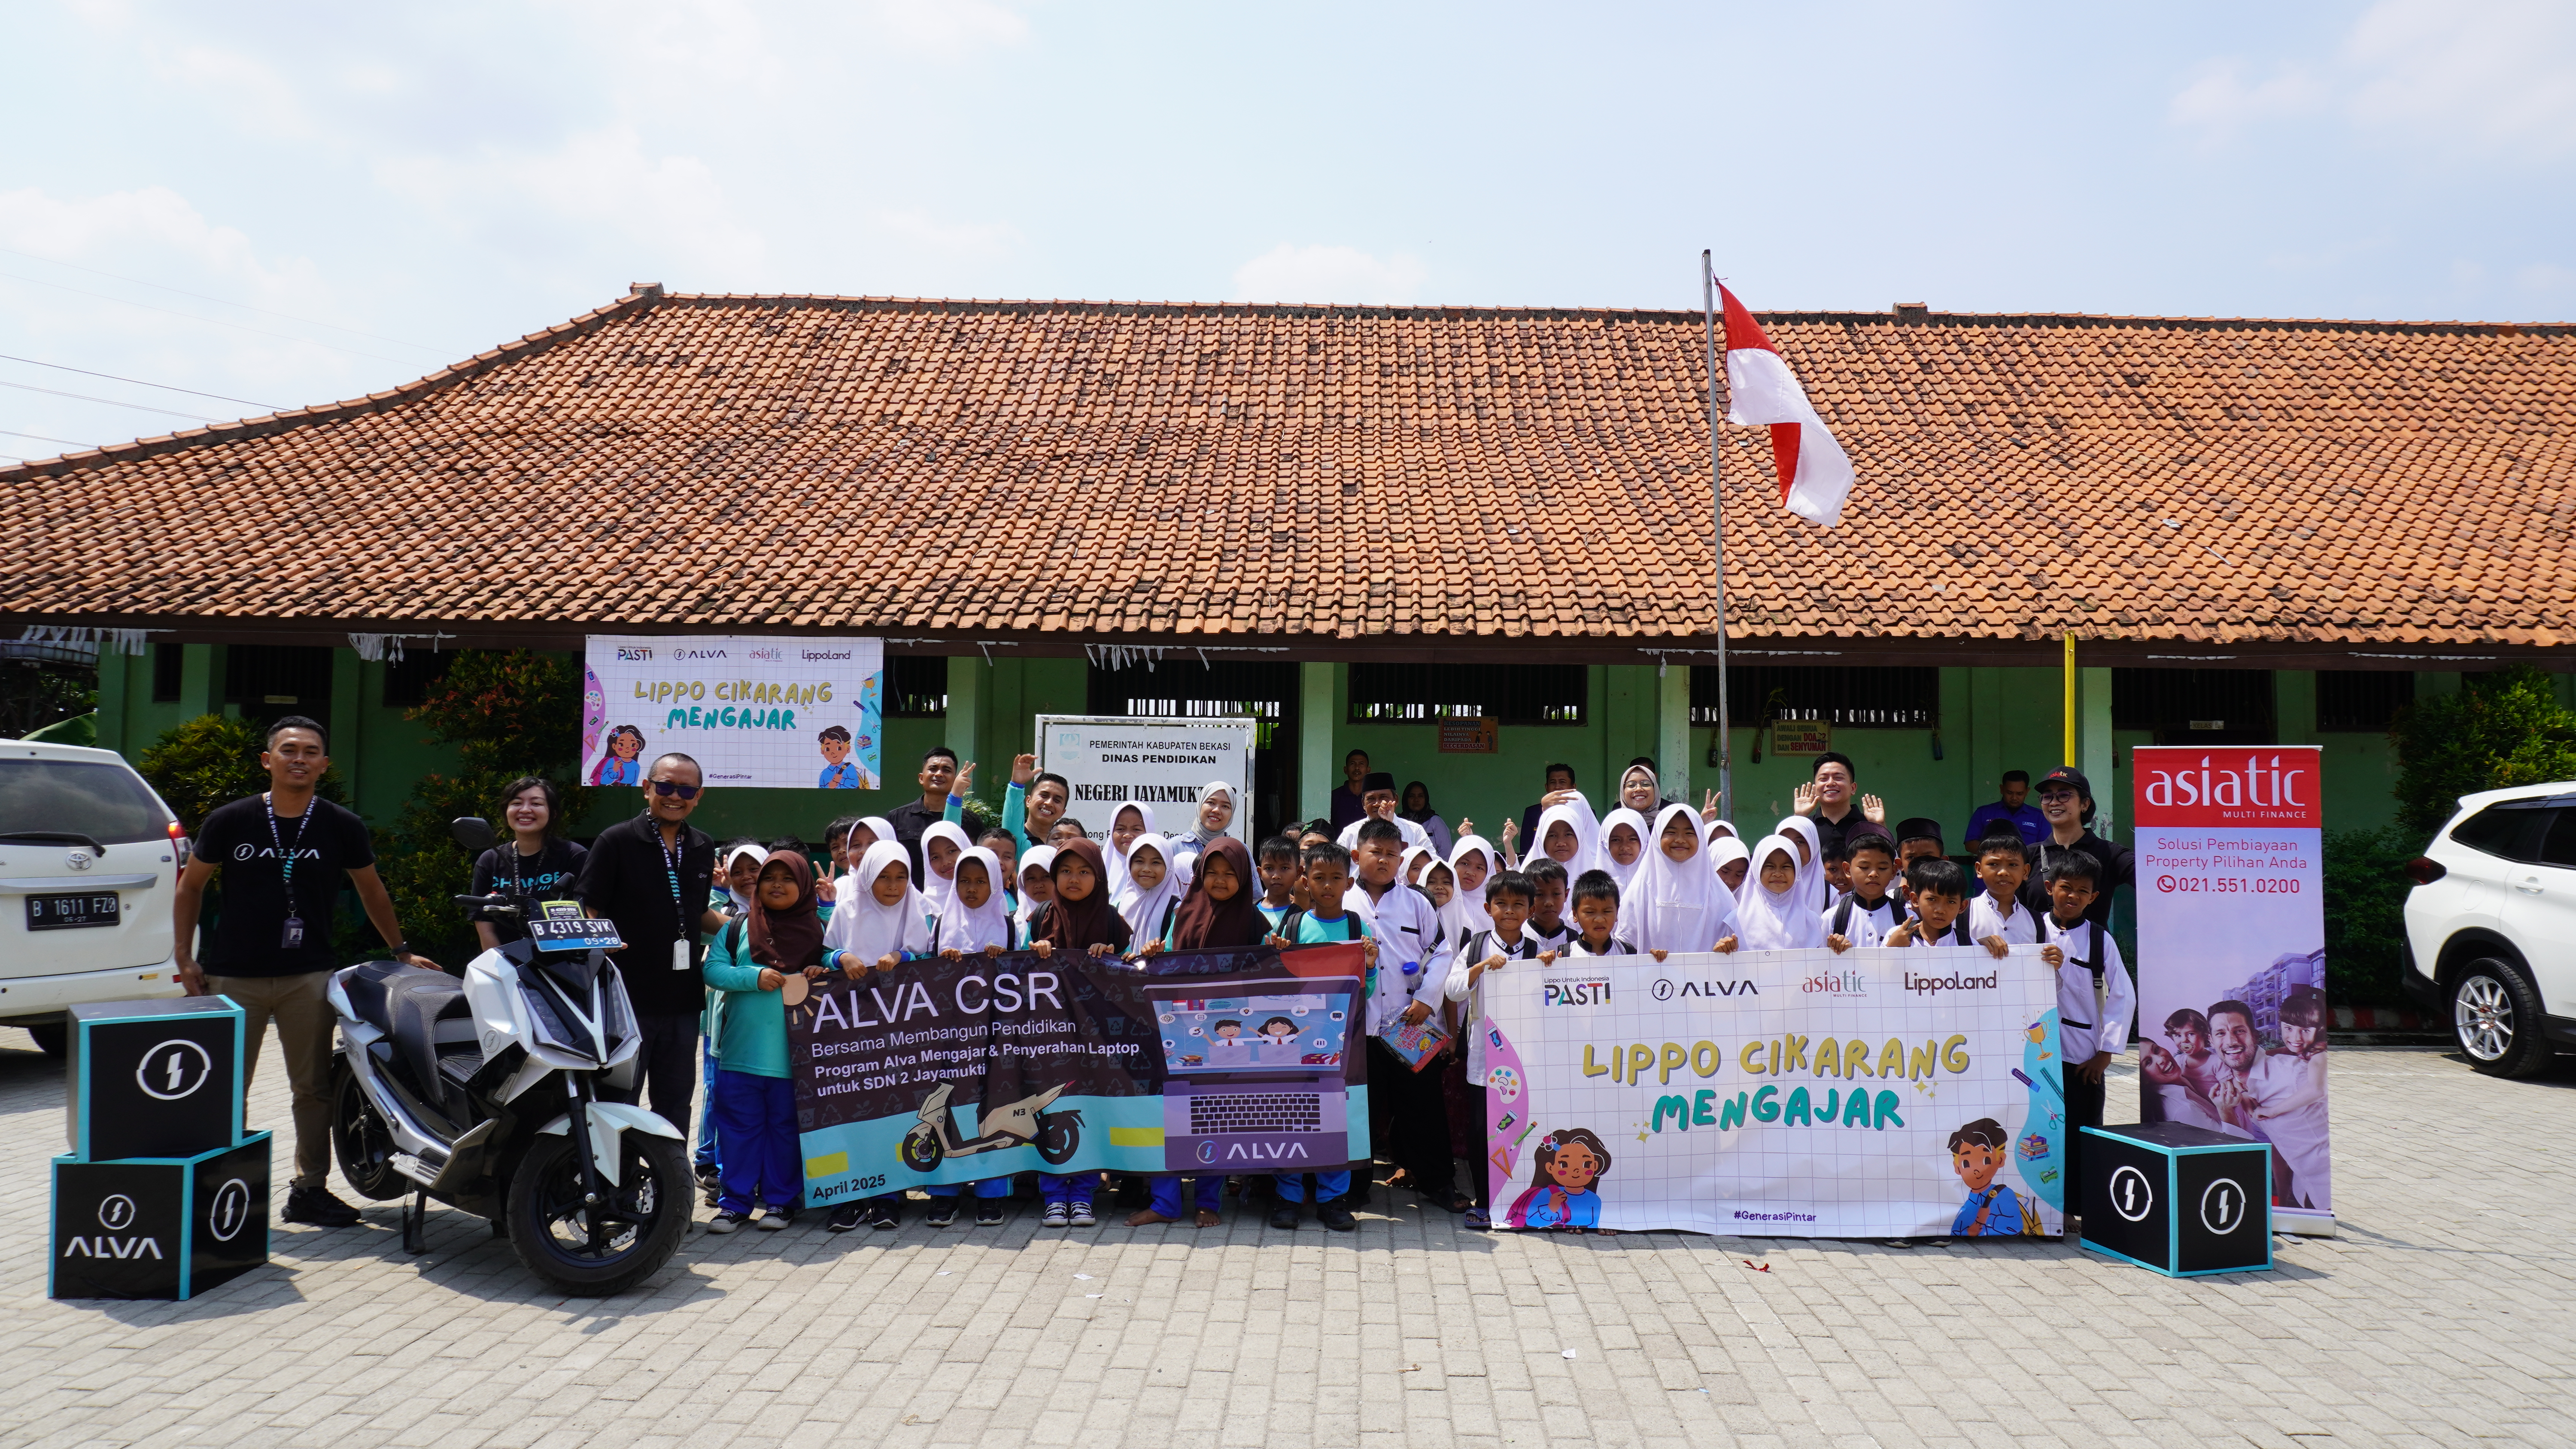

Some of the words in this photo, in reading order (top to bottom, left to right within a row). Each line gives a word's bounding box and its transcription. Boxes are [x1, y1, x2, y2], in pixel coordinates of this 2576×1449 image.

[688, 650, 727, 658] ALVA
[749, 648, 783, 660] asiatic
[802, 649, 851, 662] LippoLand
[635, 680, 705, 704] LIPPO
[715, 679, 832, 705] CIKARANG
[667, 706, 796, 731] MENGAJAR
[1090, 740, 1143, 749] PEMERINTAH
[1146, 741, 1197, 750] KABUPATEN
[1200, 743, 1230, 751] BEKASI
[1804, 733, 1817, 741] DOA
[1790, 742, 1825, 751] SENYUMAN
[1102, 754, 1138, 763] DINAS
[1142, 755, 1216, 764] PENDIDIKAN
[2145, 755, 2306, 806] asiatic
[1075, 784, 1128, 801] NEGERI
[305, 795, 317, 815] HANGE
[301, 817, 309, 829] THE
[657, 836, 666, 847] THE
[2158, 838, 2202, 850] Solusi
[2208, 838, 2298, 853] Pembiayaan
[2147, 855, 2208, 870] Property
[2214, 856, 2264, 868] Pilihan
[2269, 857, 2307, 868] Anda
[2179, 878, 2300, 893] 021.551.0200
[33, 900, 42, 917] B
[55, 898, 84, 915] 1611
[533, 924, 544, 936] B
[550, 921, 583, 934] 4319
[586, 921, 612, 933] SVK
[1680, 980, 1759, 997] ALVA
[1802, 970, 1866, 993] asiatic
[1905, 970, 1997, 996] LippoLand
[812, 981, 939, 1034] ALVA
[955, 972, 1063, 1014] CSR
[1544, 983, 1610, 1006] PASTI
[812, 1036, 885, 1058] Bersama
[890, 1023, 987, 1047] Membangun
[992, 1019, 1076, 1036] Pendidikan
[815, 1061, 879, 1078] Program
[884, 1055, 916, 1069] Alva
[921, 1045, 986, 1064] Mengajar
[989, 1046, 999, 1057] &
[1003, 1041, 1085, 1058] Penyerahan
[1089, 1043, 1139, 1057] Laptop
[1583, 1040, 1721, 1086] LIPPO
[1740, 1034, 1970, 1082] CIKARANG
[817, 1082, 860, 1097] untuk
[863, 1076, 896, 1090] SDN
[901, 1072, 909, 1084] 2
[913, 1064, 986, 1082] Jayamukti
[1013, 1108, 1026, 1117] N3
[1652, 1085, 1905, 1133] MENGAJAR
[1227, 1143, 1309, 1160] ALVA
[813, 1181, 848, 1200] April
[851, 1174, 886, 1191] 2025
[1734, 1209, 1817, 1223] #GenerasiPintar
[63, 1236, 163, 1260] ALVA
